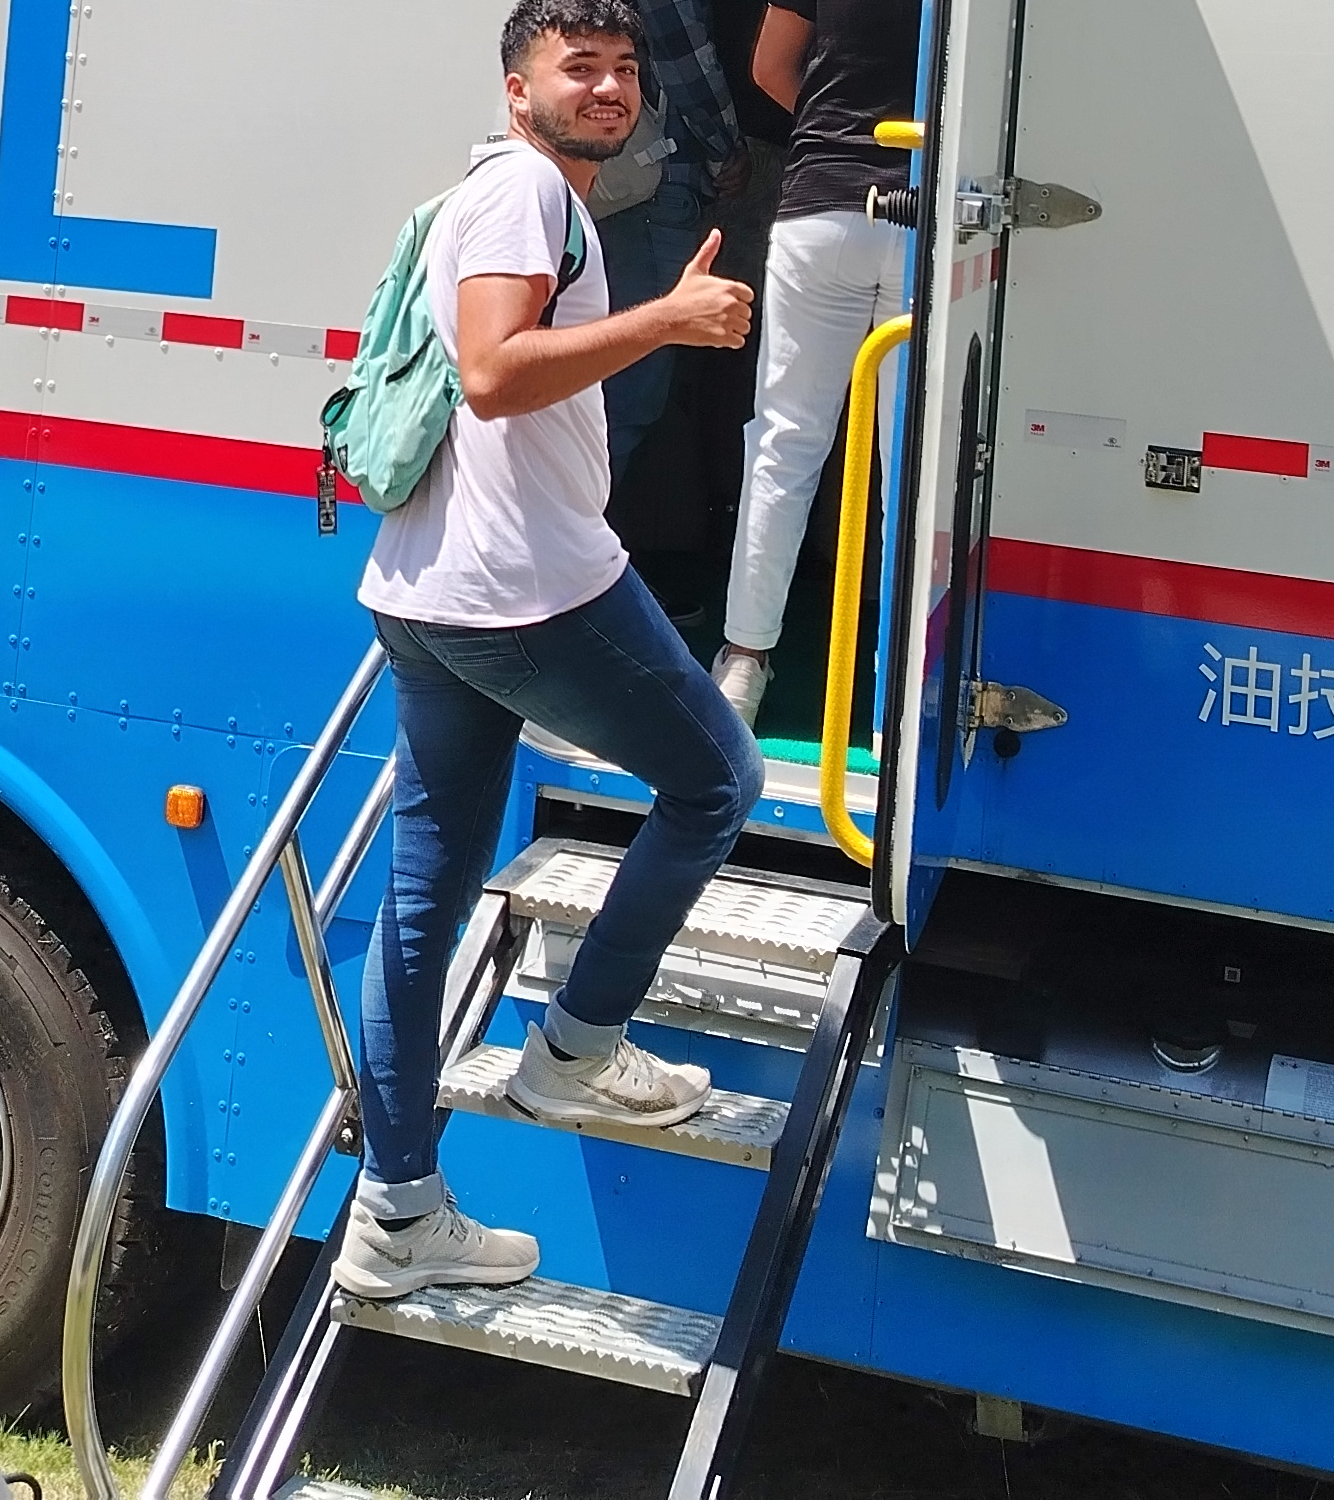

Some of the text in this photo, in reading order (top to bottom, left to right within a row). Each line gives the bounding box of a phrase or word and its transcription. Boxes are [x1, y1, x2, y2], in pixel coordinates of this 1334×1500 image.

[247, 332, 260, 342] 3M
[1030, 423, 1045, 432] 3M
[1314, 459, 1330, 469] 3M
